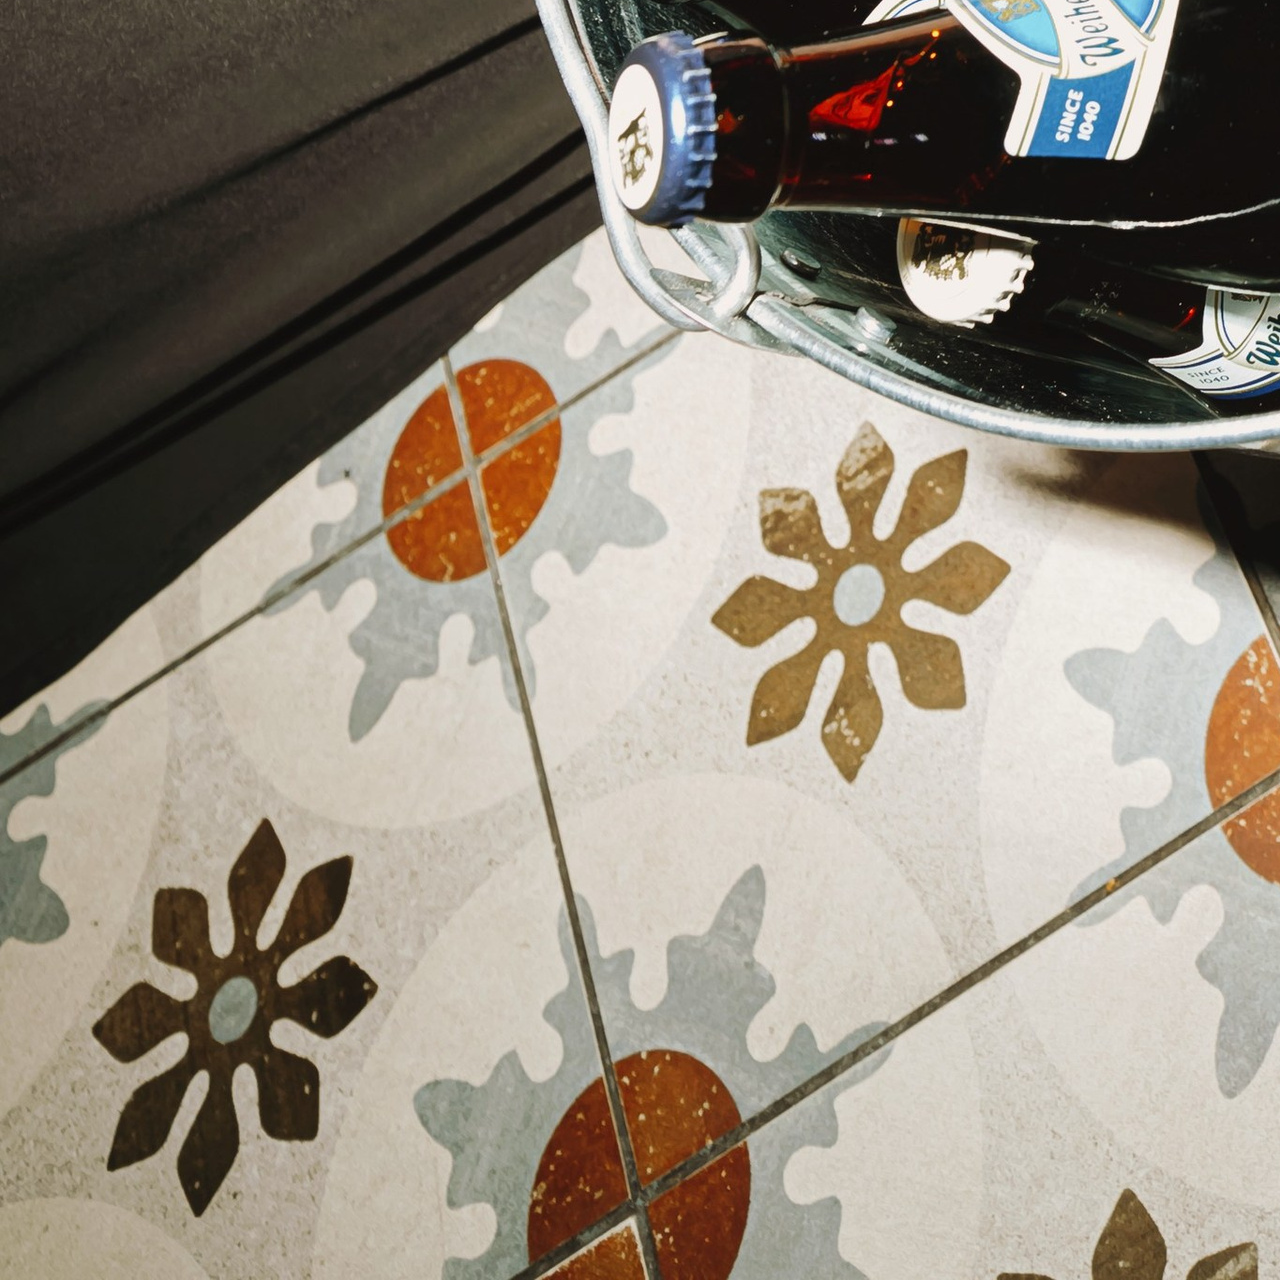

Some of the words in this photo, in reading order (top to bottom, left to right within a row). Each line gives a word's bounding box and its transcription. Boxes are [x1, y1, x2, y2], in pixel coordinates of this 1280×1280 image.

[1055, 88, 1084, 143] SINCE
[1076, 100, 1101, 141] 1040
[1187, 366, 1224, 379] SINCE
[1198, 374, 1230, 386] 1040
